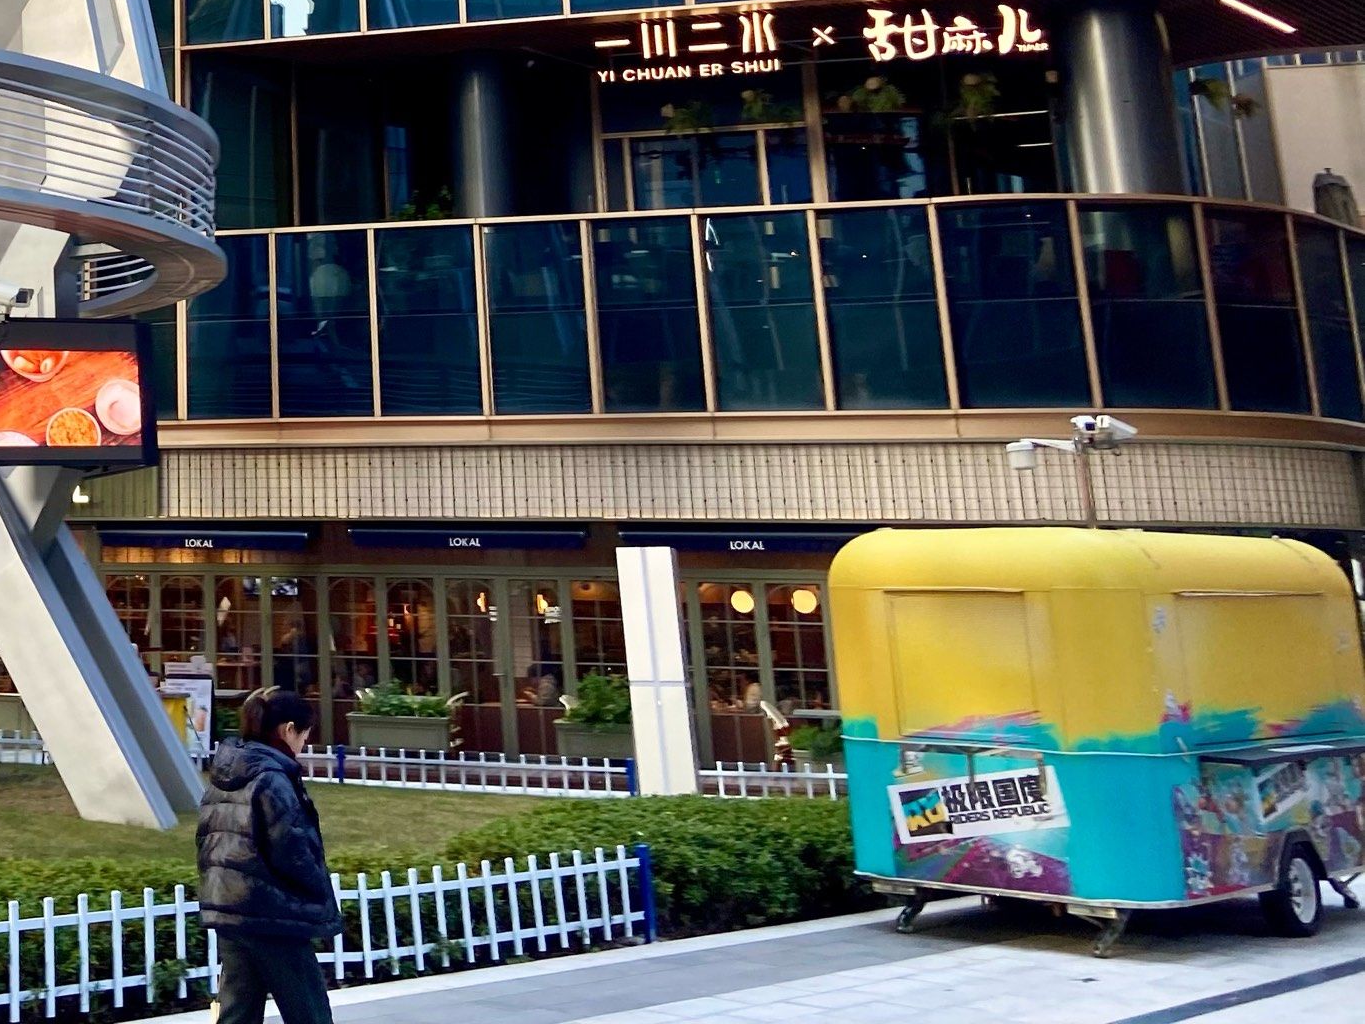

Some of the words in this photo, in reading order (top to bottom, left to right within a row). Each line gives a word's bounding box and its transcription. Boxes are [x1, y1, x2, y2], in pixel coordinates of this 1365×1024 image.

[862, 4, 1042, 62] 甜麻儿
[597, 69, 616, 83] YI
[622, 65, 691, 82] CHUAN
[699, 63, 725, 77] ER
[731, 58, 782, 74] SHUI
[185, 538, 213, 548] LOKAL
[449, 537, 481, 547] LOKAL
[729, 540, 765, 550] LOKAL
[941, 775, 1048, 813] 极限国度
[949, 810, 990, 825] RIDERS
[992, 802, 1052, 819] REPUBLIC
